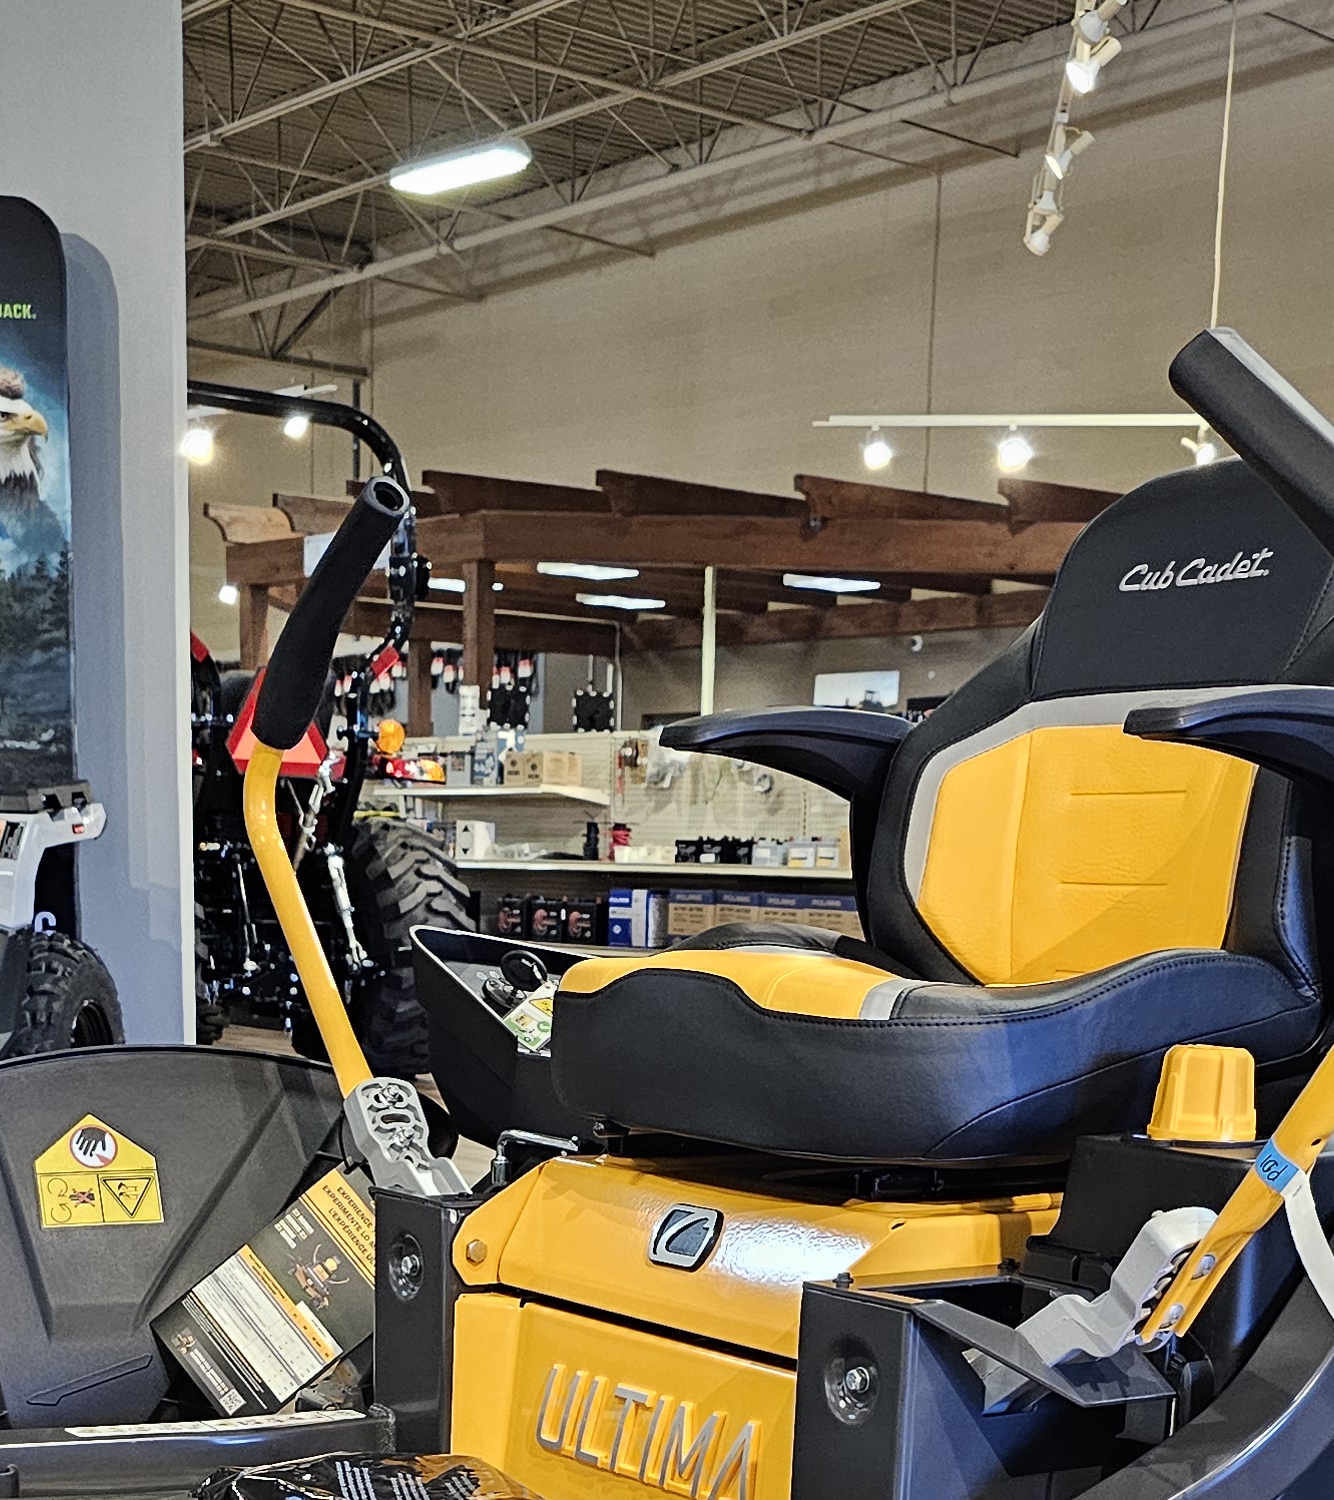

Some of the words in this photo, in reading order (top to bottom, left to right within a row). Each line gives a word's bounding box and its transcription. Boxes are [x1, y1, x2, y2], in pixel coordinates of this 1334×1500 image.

[1119, 561, 1175, 591] Cub
[322, 1185, 362, 1232] EXPERIMENTE
[337, 1186, 373, 1229] EXPERIENCE
